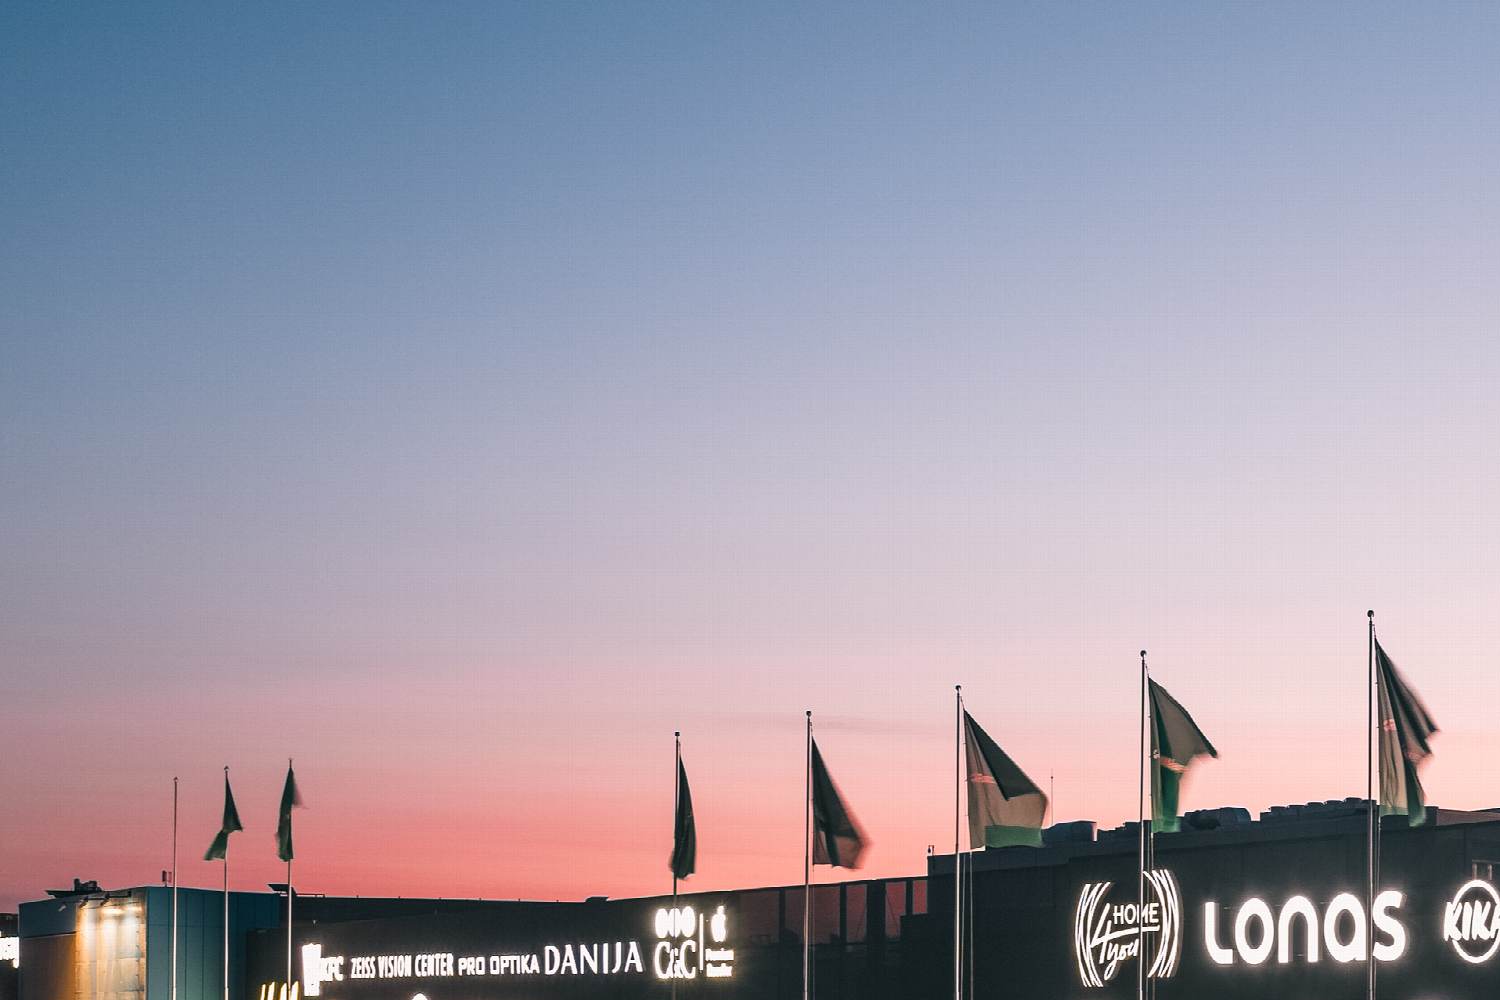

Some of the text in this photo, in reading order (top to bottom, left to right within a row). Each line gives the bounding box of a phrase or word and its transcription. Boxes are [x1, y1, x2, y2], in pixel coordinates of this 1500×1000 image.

[1112, 902, 1160, 925] HOME
[350, 952, 454, 979] ZEISS VISION CENTER
[457, 954, 541, 976] PRO OPTIKA
[544, 941, 644, 976] DANIJA
